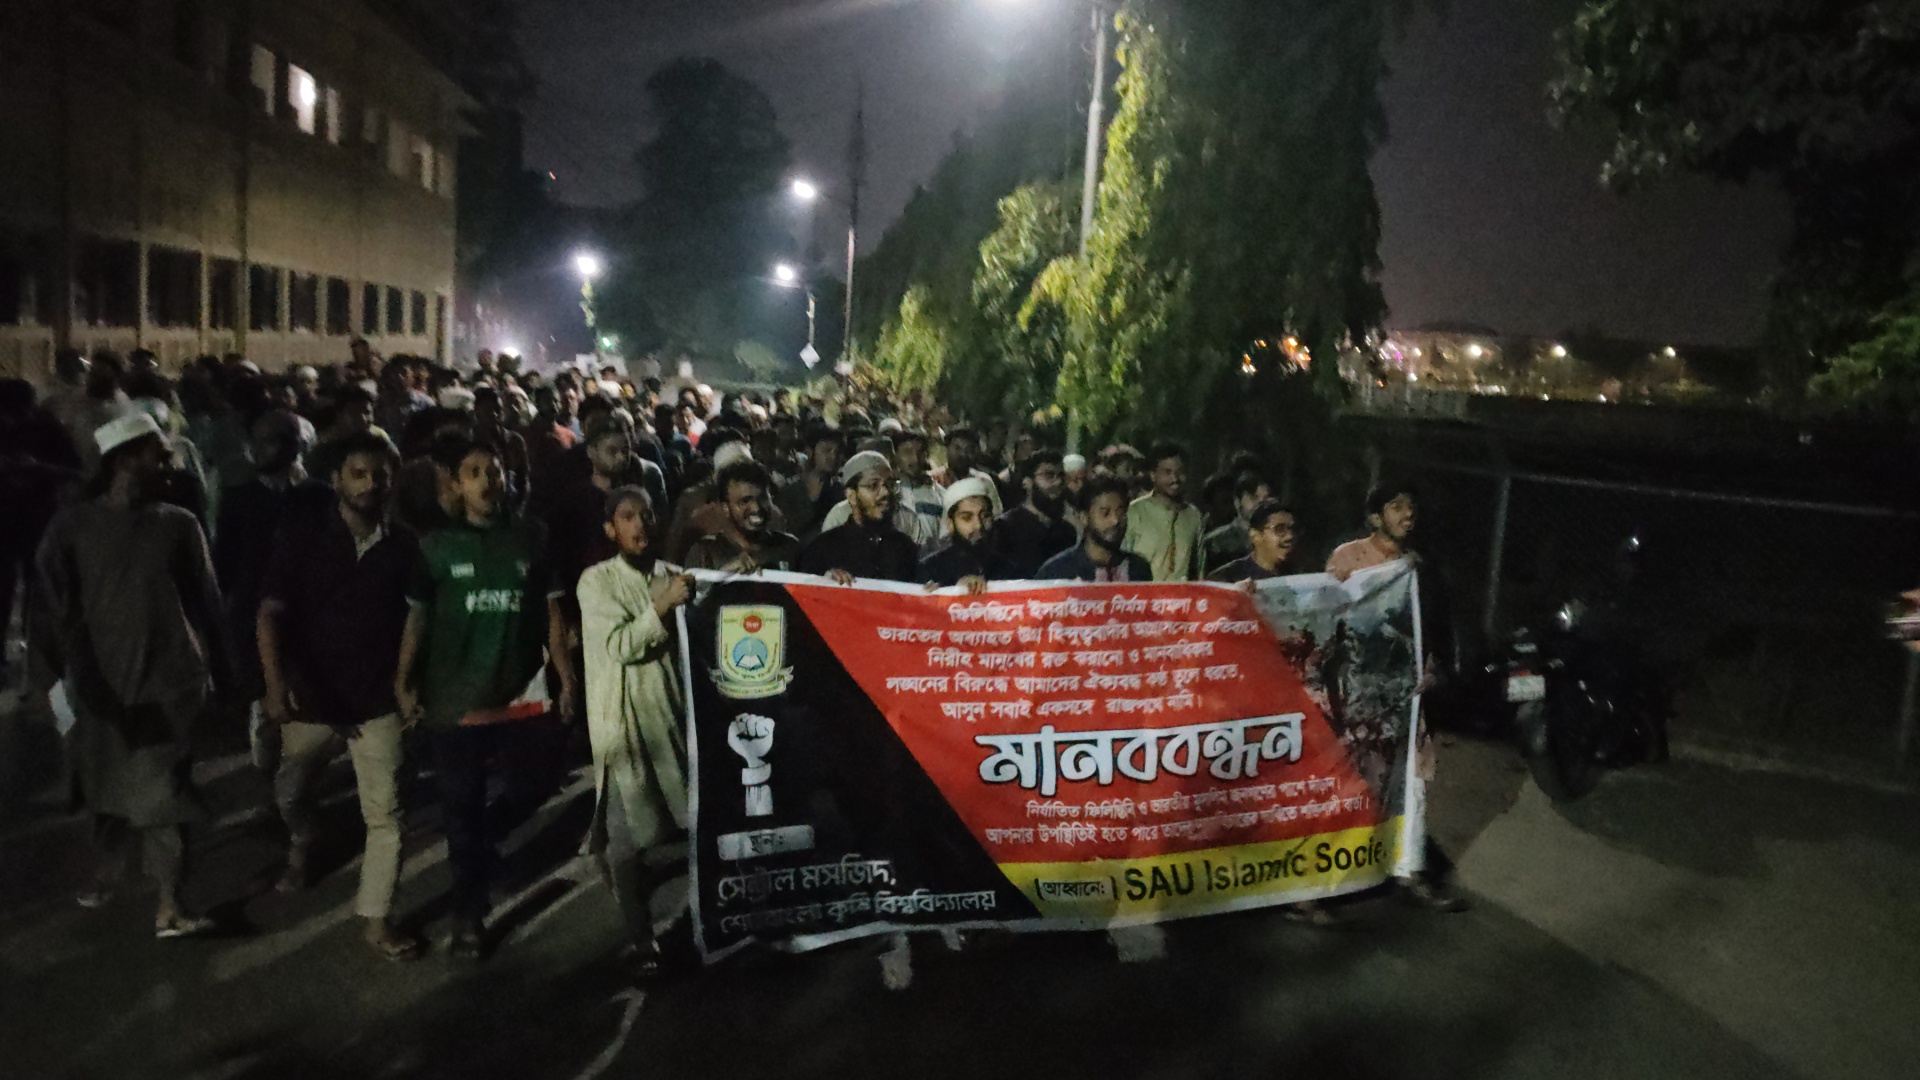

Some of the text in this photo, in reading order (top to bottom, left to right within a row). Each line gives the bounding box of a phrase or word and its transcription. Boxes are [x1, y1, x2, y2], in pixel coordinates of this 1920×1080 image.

[1196, 599, 1208, 612] ও
[877, 626, 944, 643] ভারতের
[927, 647, 973, 668] নিরীহ
[978, 651, 1035, 671] মানুষের
[1128, 650, 1139, 663] ও
[954, 671, 1009, 692] বিরুদ্ধে
[1013, 676, 1081, 694] আমাদের
[941, 702, 986, 722] আসুন
[990, 698, 1033, 719] সবাই
[974, 712, 1306, 796] মানববন্ধন
[1026, 799, 1080, 818] নির্যাতিত
[1084, 797, 1136, 819] ফিলিস্তিনি
[1137, 801, 1147, 815] ও
[985, 827, 1033, 844] আপনার
[1038, 821, 1098, 847] উপস্থিতিই
[1101, 826, 1127, 842] হতে
[1131, 826, 1158, 841] পারে
[1126, 863, 1194, 901] SAU
[1207, 853, 1305, 891] Islamic
[875, 889, 996, 914] বিশ্ববিদ্যালয়
